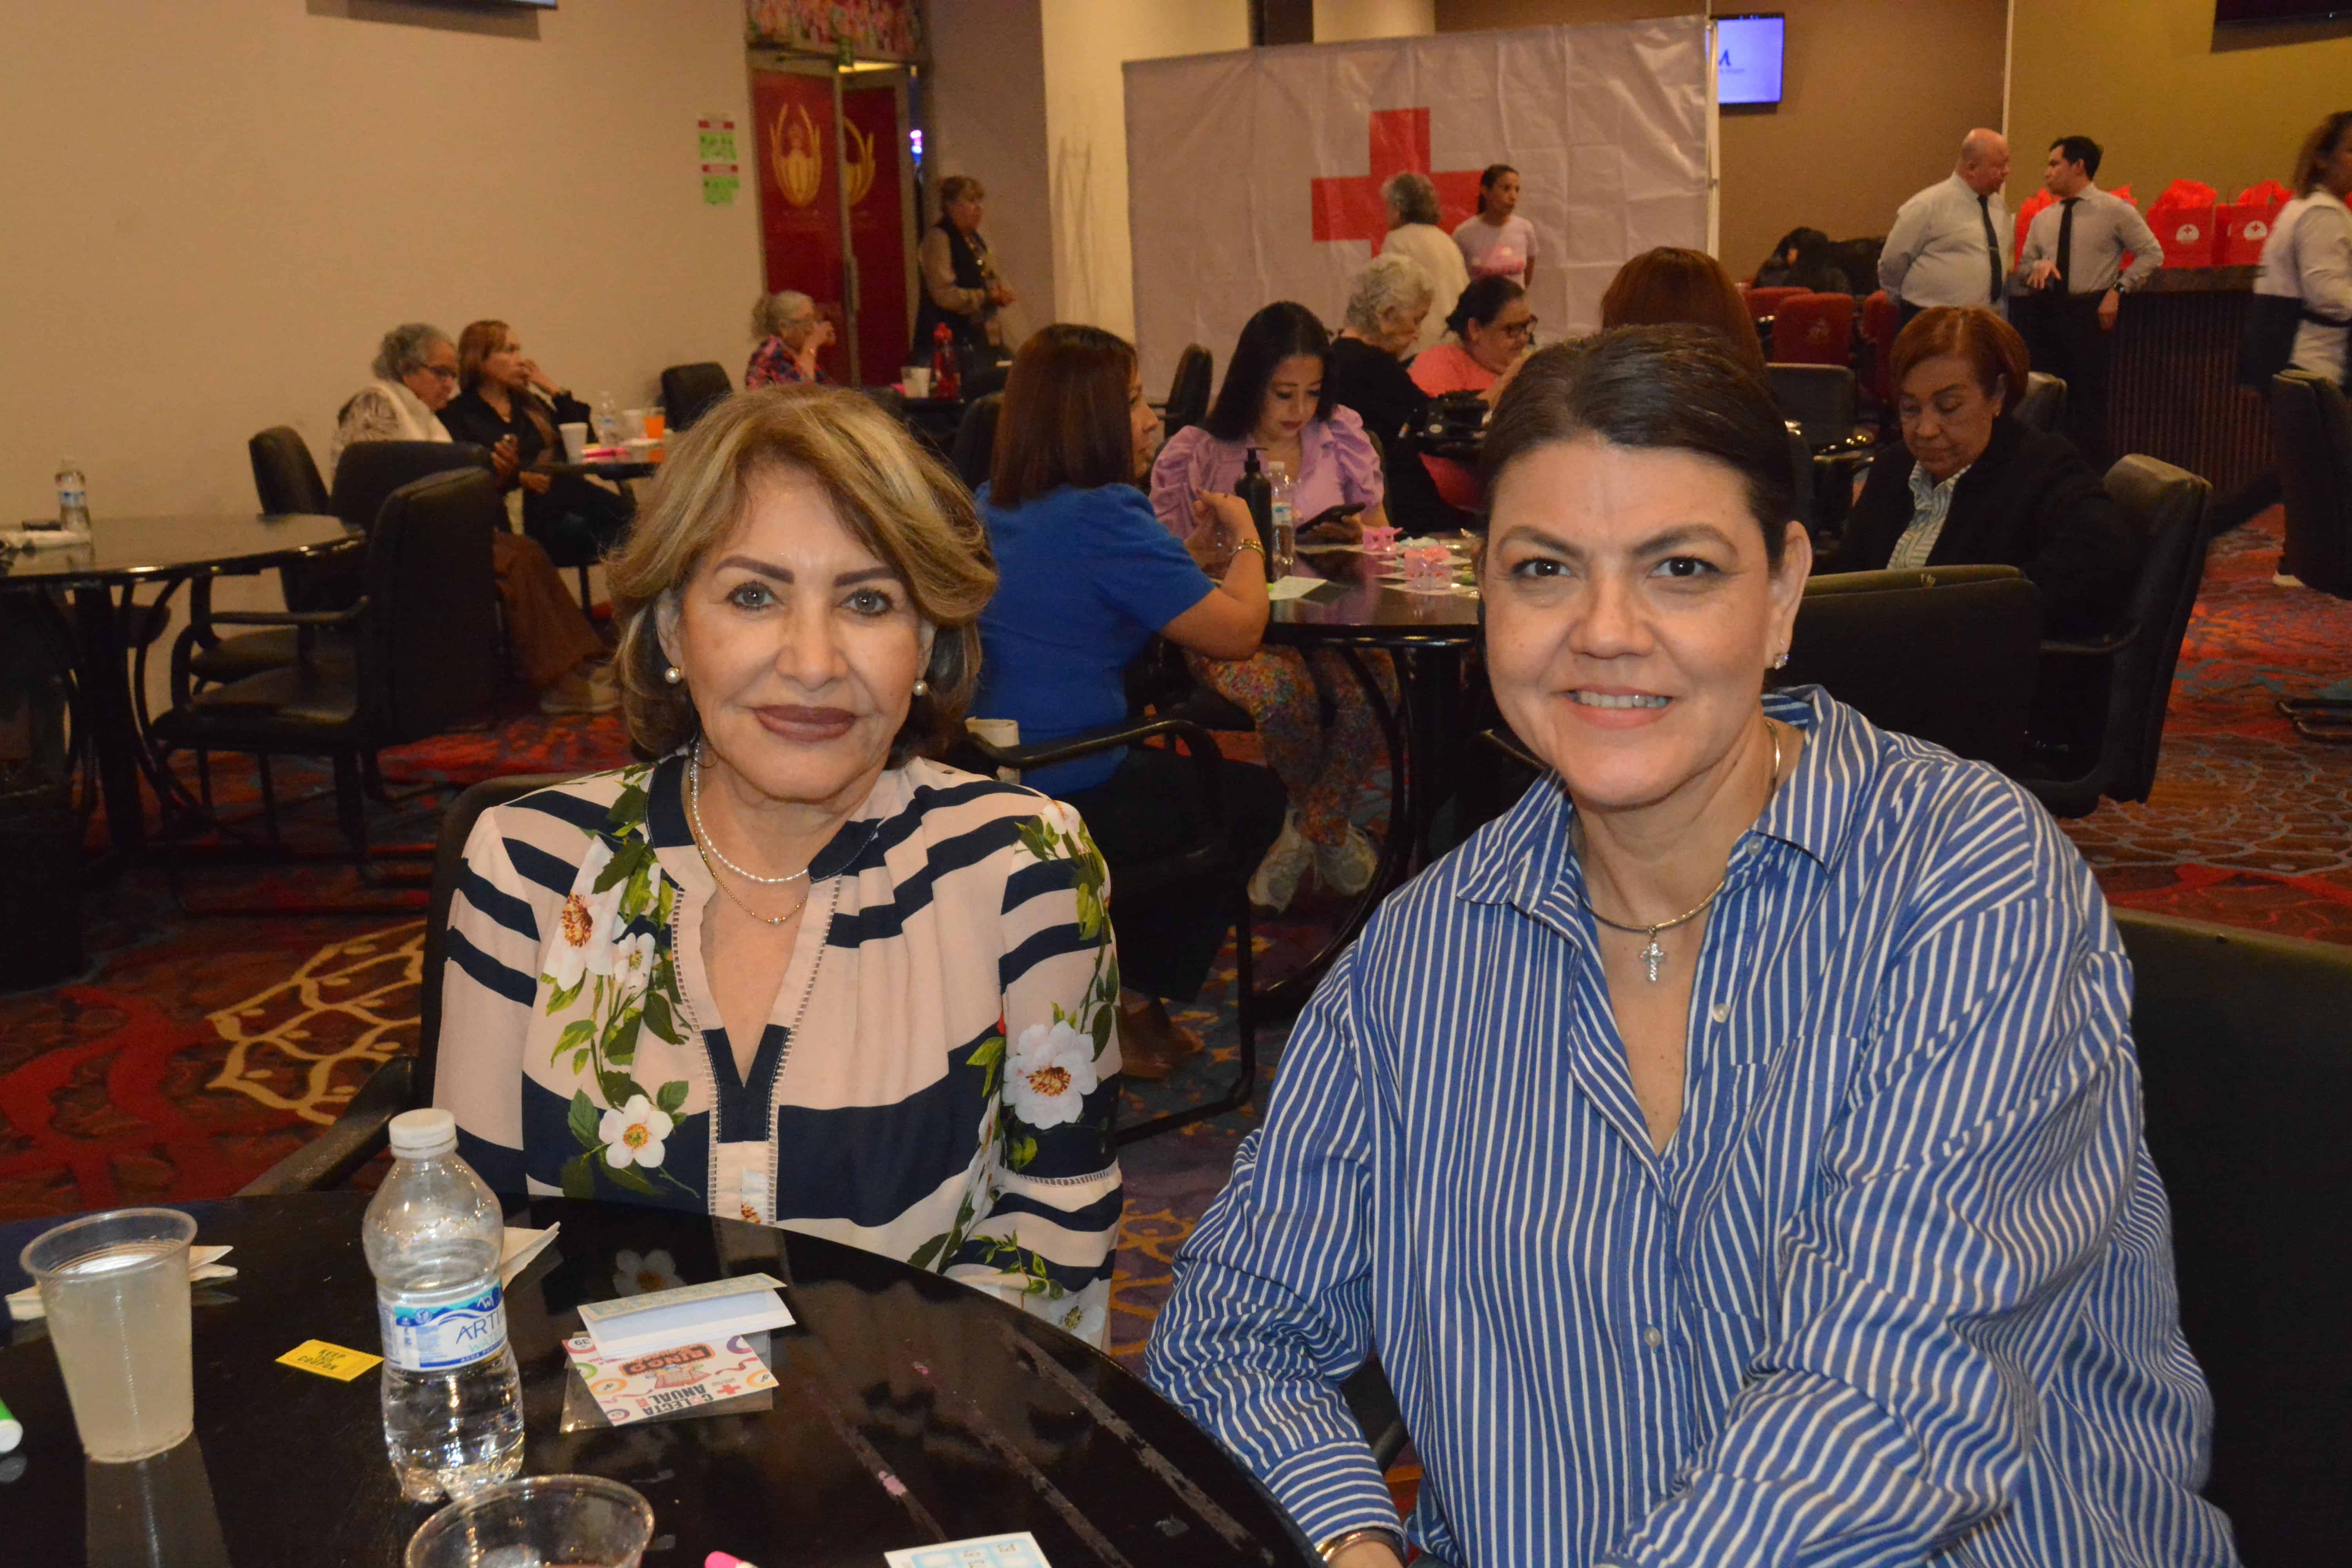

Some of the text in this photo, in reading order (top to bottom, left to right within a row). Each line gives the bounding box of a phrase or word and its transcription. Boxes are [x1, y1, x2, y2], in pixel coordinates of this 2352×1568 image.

[319, 1349, 346, 1359] KEEP
[298, 1355, 339, 1371] COUPON
[648, 1384, 707, 1405] ANUAL
